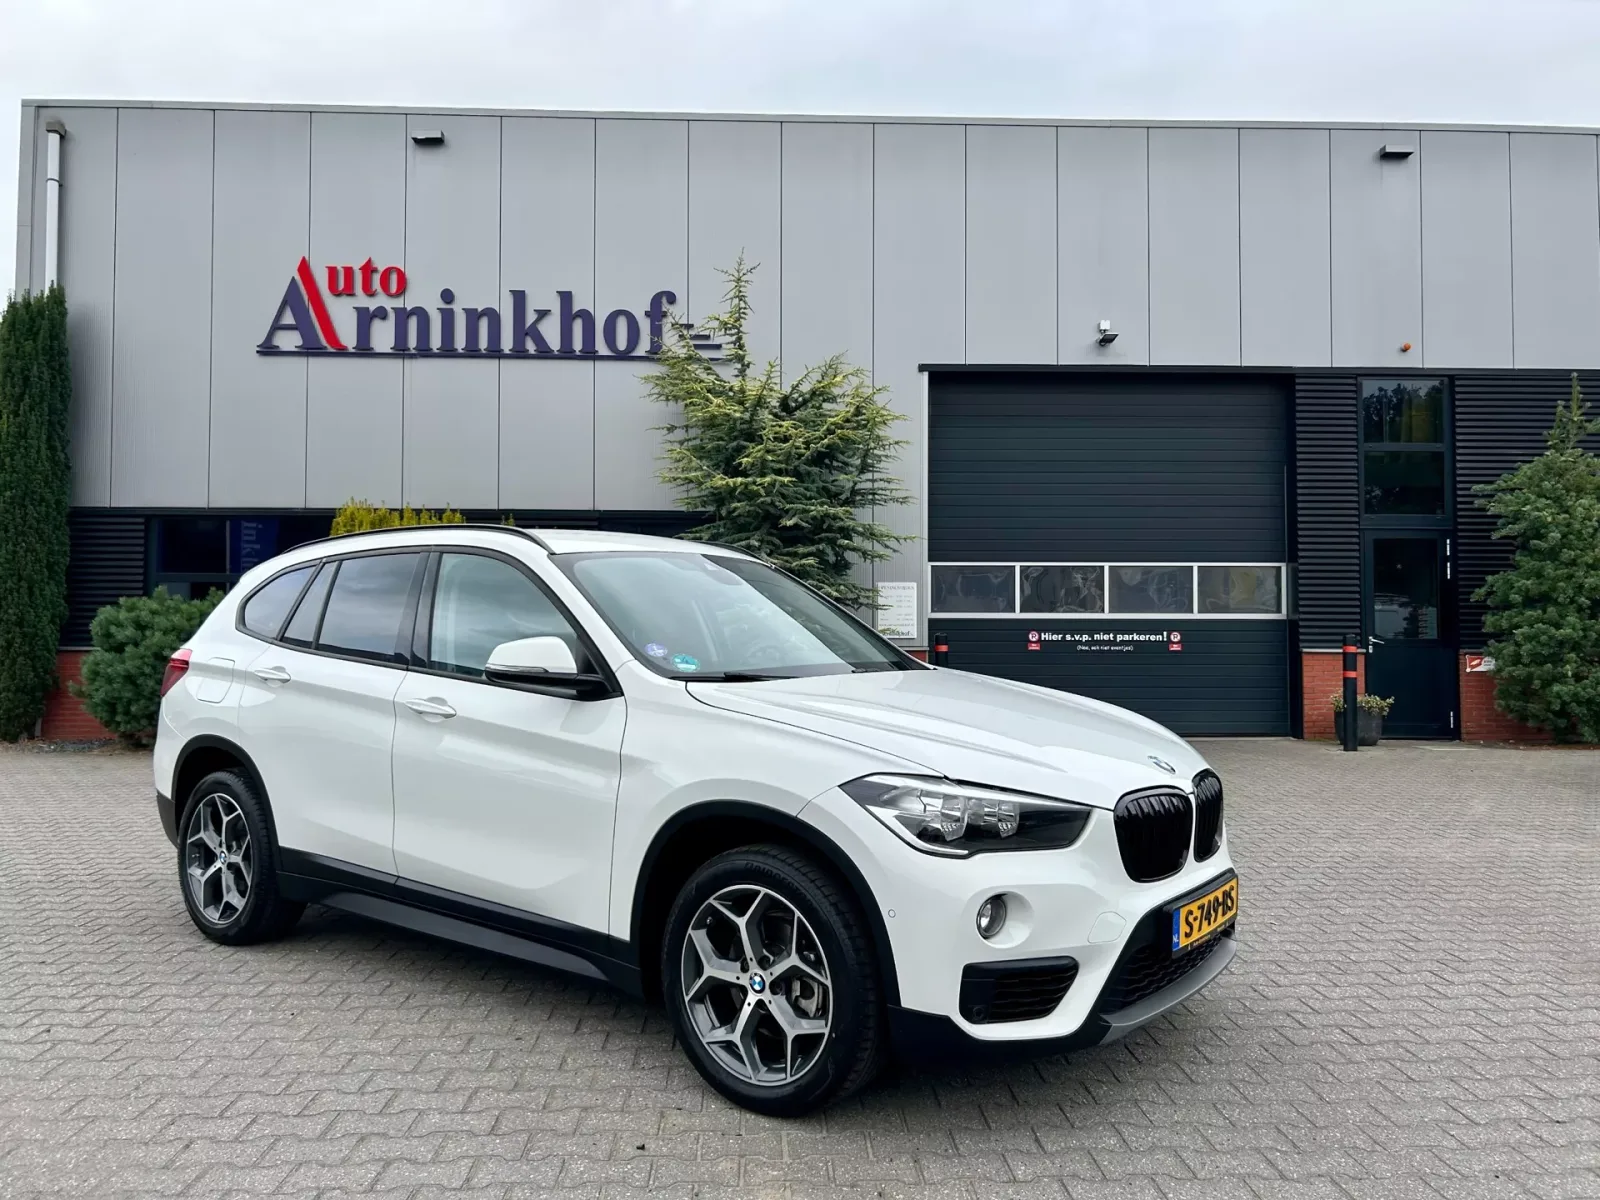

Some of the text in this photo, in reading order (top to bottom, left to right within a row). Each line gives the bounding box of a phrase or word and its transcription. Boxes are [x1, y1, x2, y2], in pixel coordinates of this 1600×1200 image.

[256, 275, 677, 355] Arninkhof
[1041, 631, 1168, 642] Hier s.v.p. niet parkeren!
[1173, 934, 1179, 943] NL
